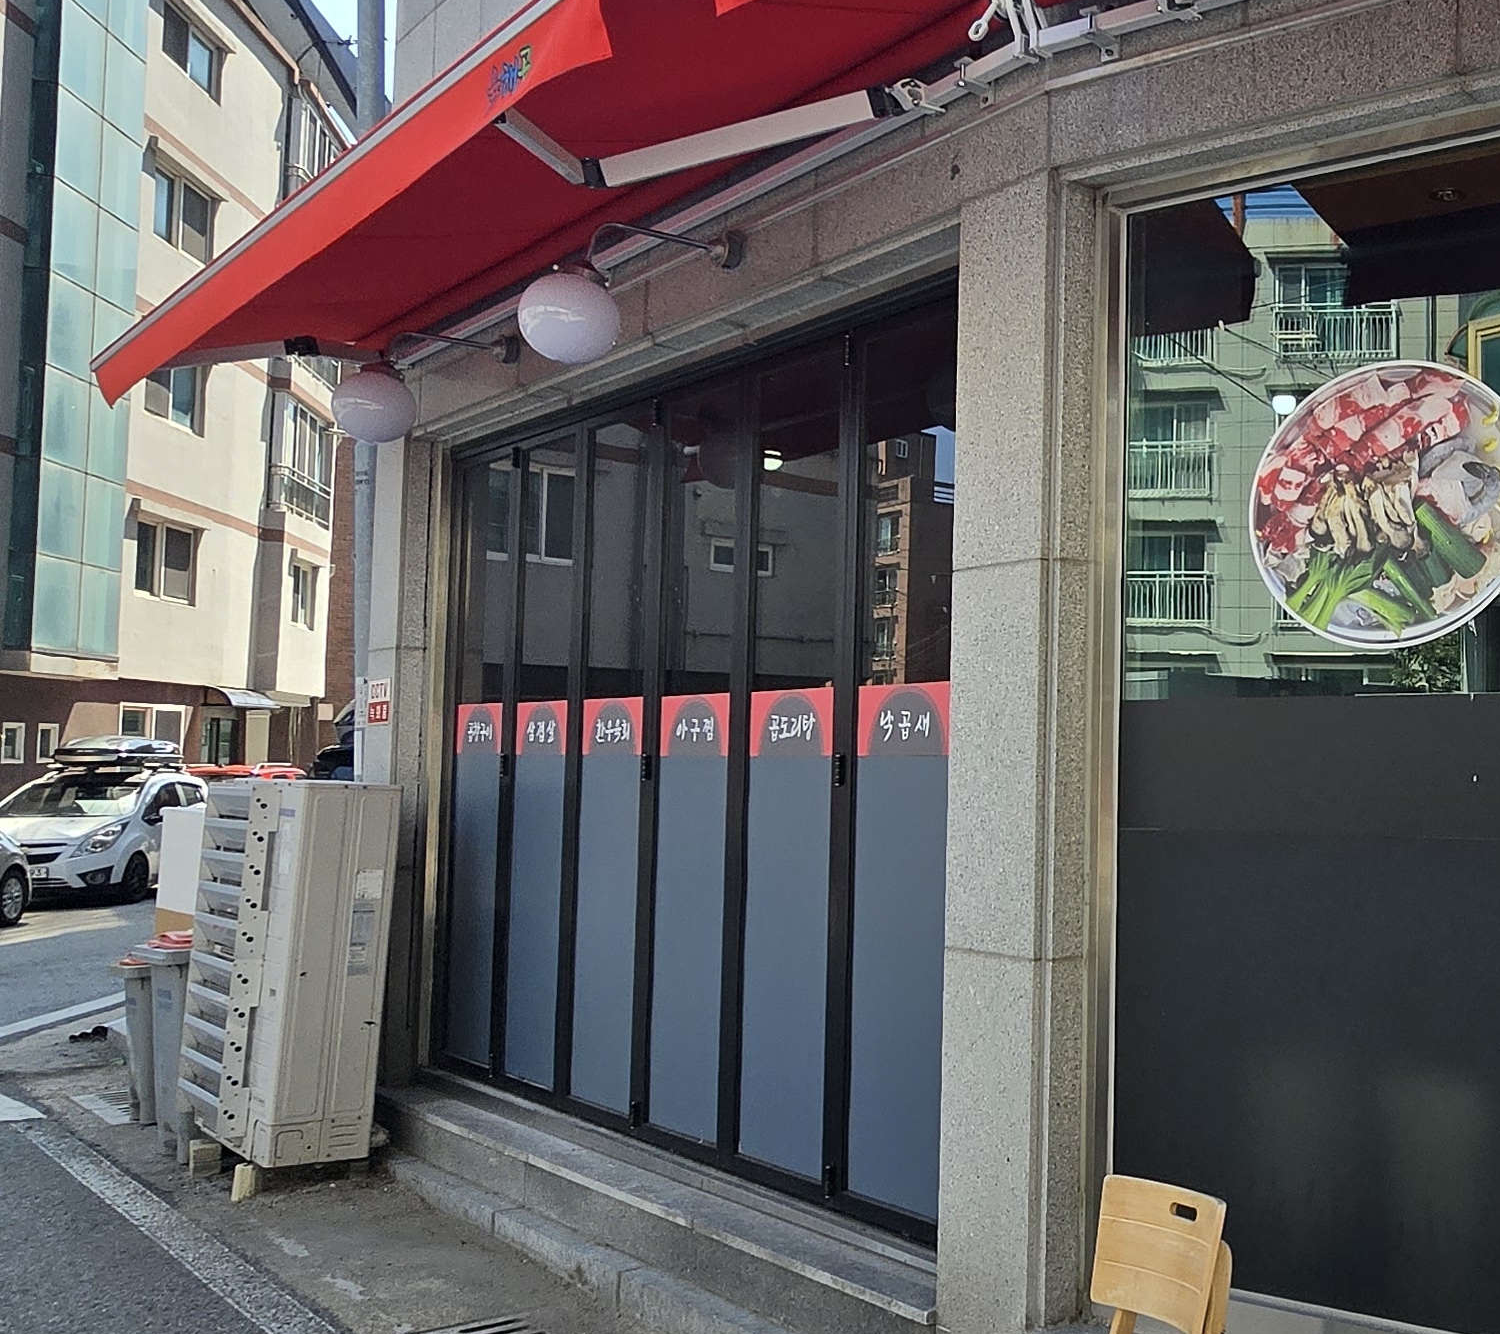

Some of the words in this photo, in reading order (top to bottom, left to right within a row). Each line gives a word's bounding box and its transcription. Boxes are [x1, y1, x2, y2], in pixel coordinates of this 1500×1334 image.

[526, 719, 557, 743] 삼겹살
[675, 716, 715, 742] 아구찜
[768, 714, 816, 743] 곱도리탕
[879, 709, 931, 742] 낙곱새
